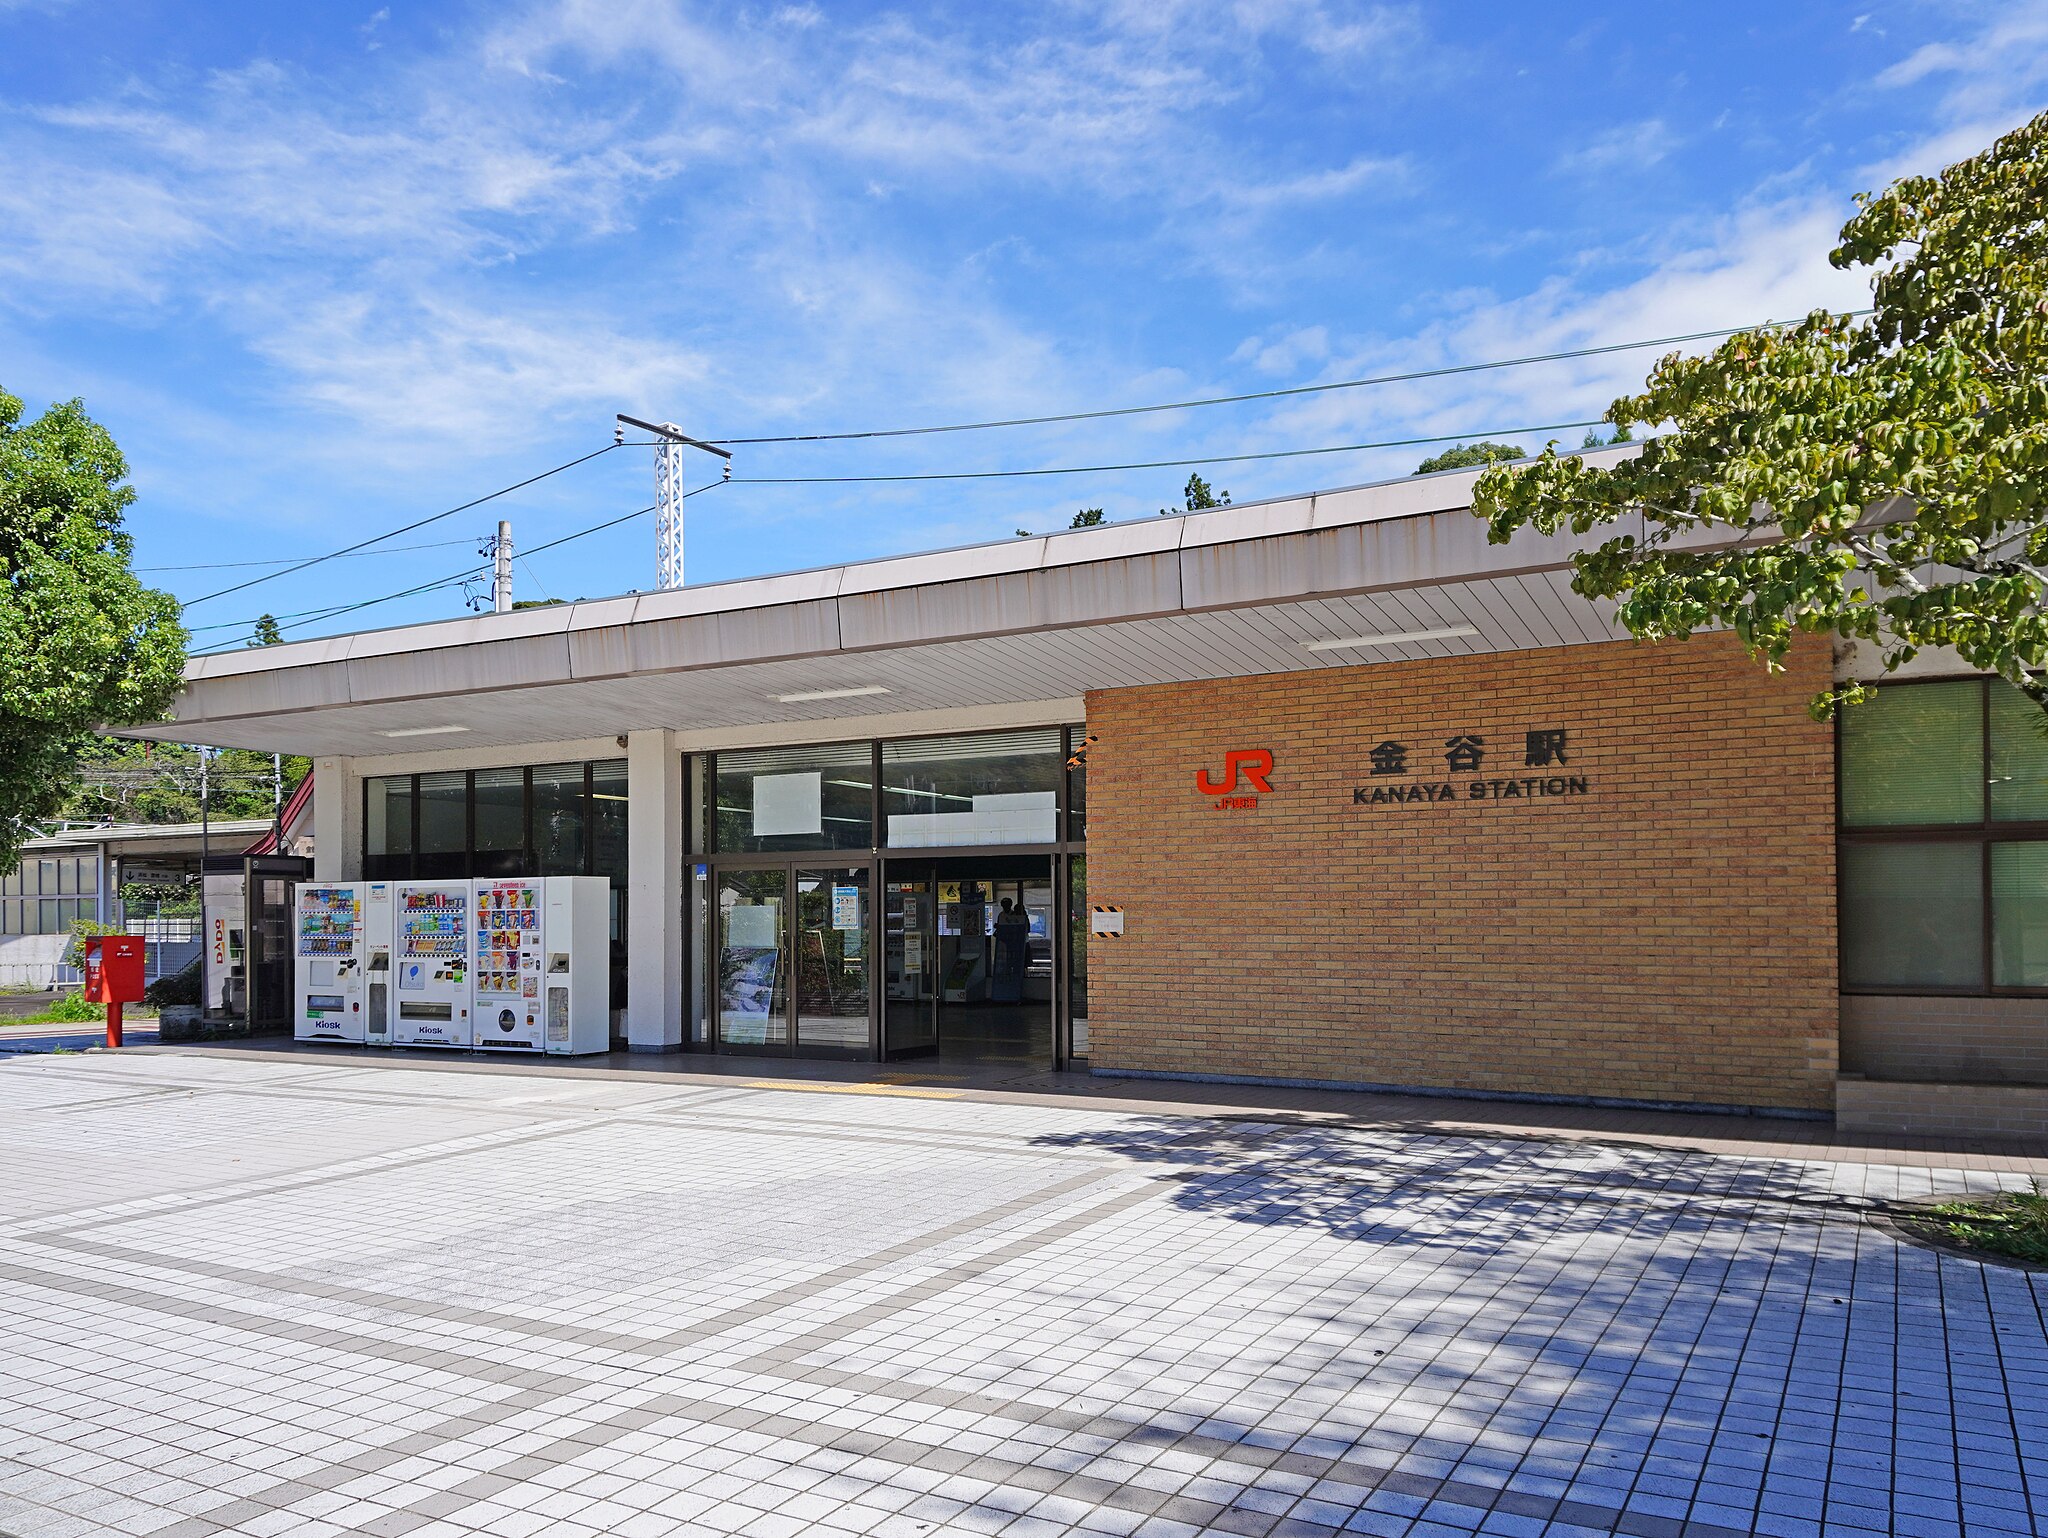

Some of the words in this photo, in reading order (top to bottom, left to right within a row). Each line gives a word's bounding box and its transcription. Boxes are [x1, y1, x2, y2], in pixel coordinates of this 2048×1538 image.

[1369, 729, 1567, 775] 金谷駅
[1197, 749, 1274, 795] JR
[1353, 784, 1456, 804] KANAYA
[1469, 777, 1588, 800] STATION
[174, 874, 181, 882] 3
[315, 1021, 341, 1030] Kiosk
[418, 1026, 443, 1035] Kiosk
